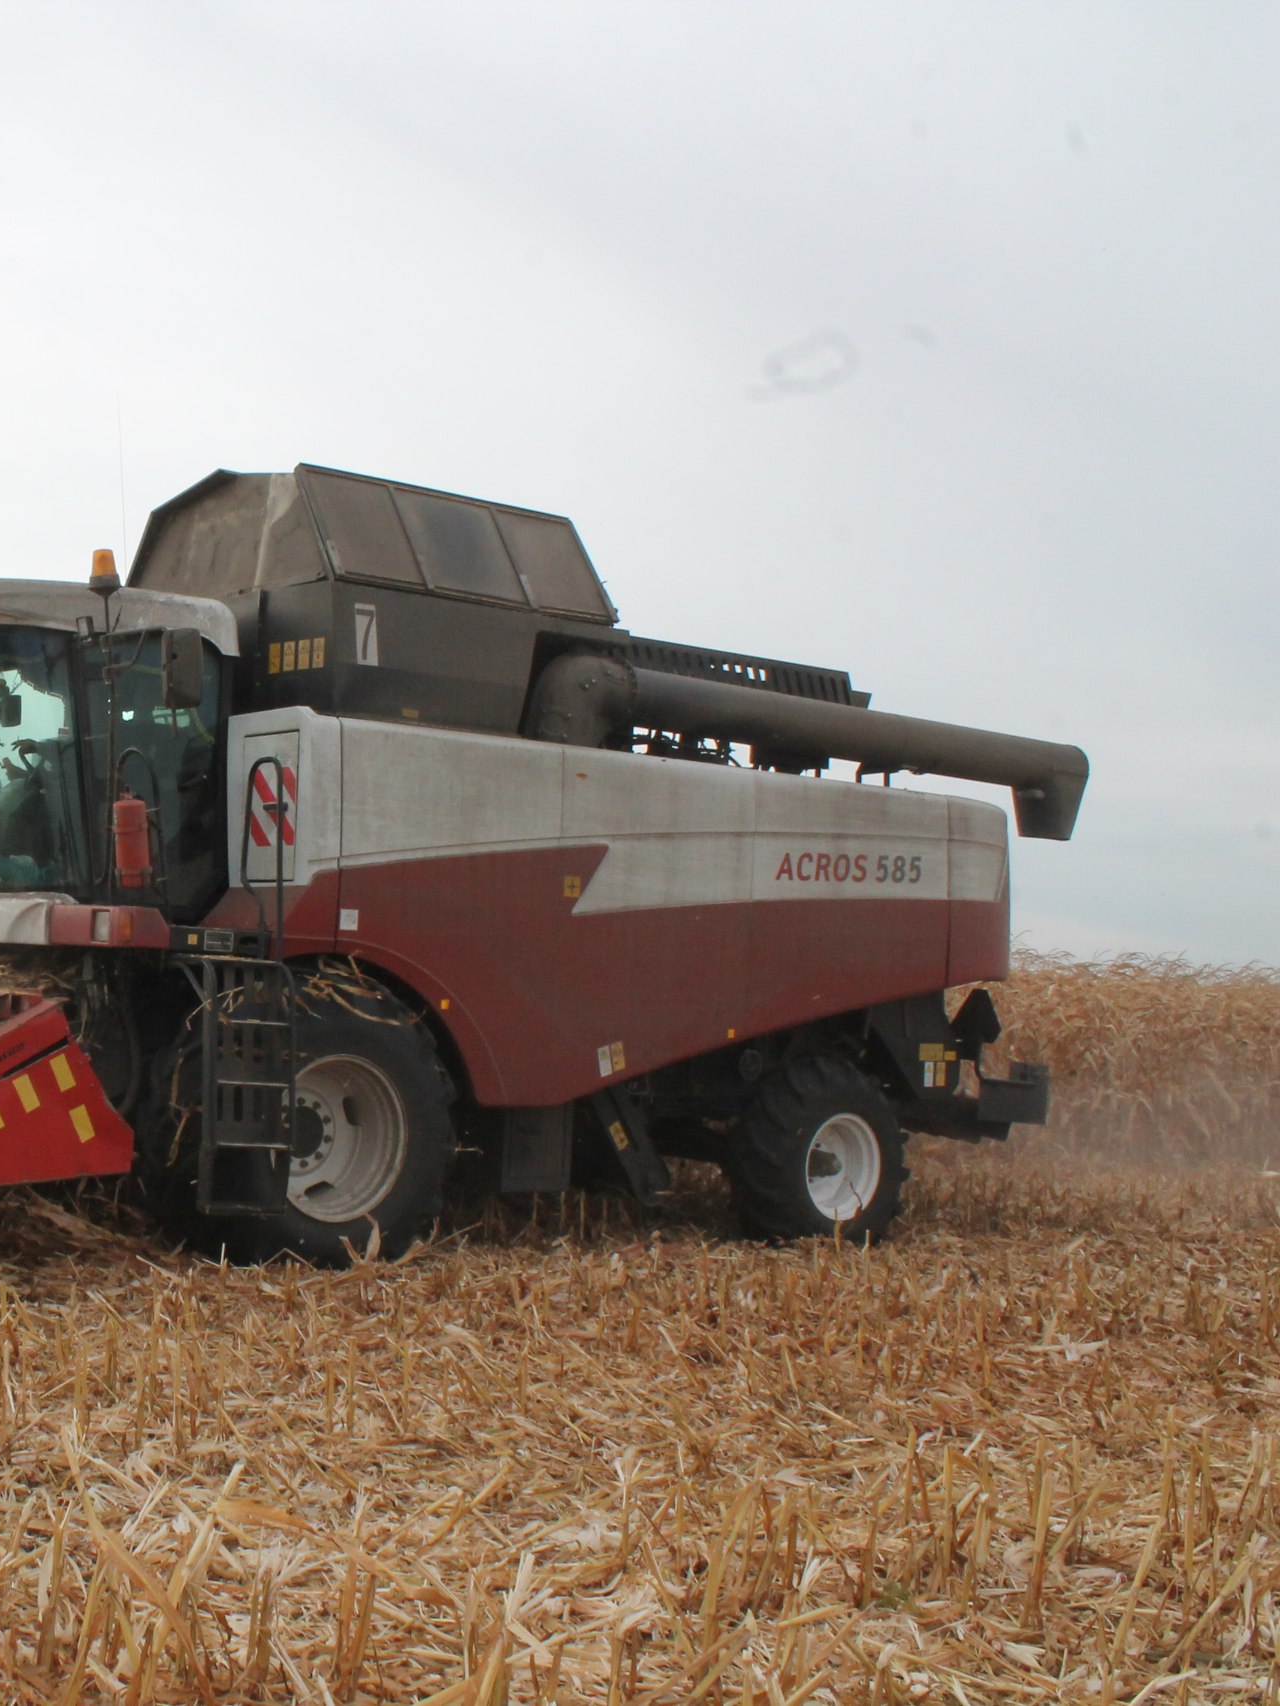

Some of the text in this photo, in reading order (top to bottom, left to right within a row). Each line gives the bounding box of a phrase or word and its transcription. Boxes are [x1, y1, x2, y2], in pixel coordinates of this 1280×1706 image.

[356, 608, 375, 661] 7
[775, 852, 922, 884] ACROS 585
